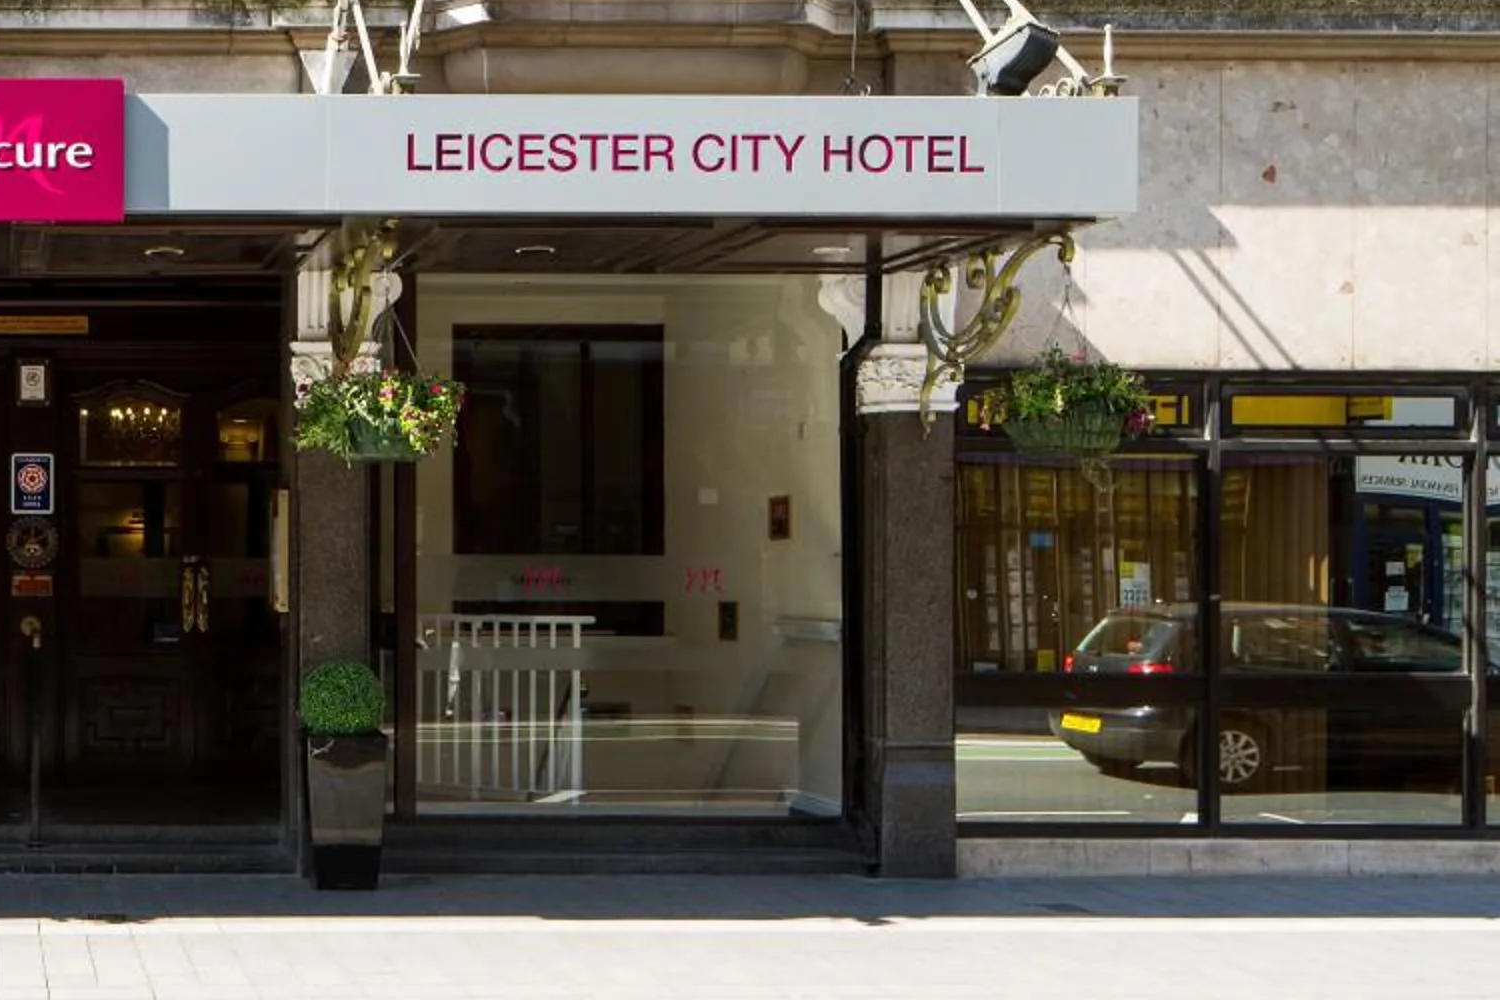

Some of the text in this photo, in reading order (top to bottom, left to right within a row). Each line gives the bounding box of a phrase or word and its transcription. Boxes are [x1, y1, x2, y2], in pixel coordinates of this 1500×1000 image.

[406, 133, 985, 173] LEICESTER CITY HOTEL
